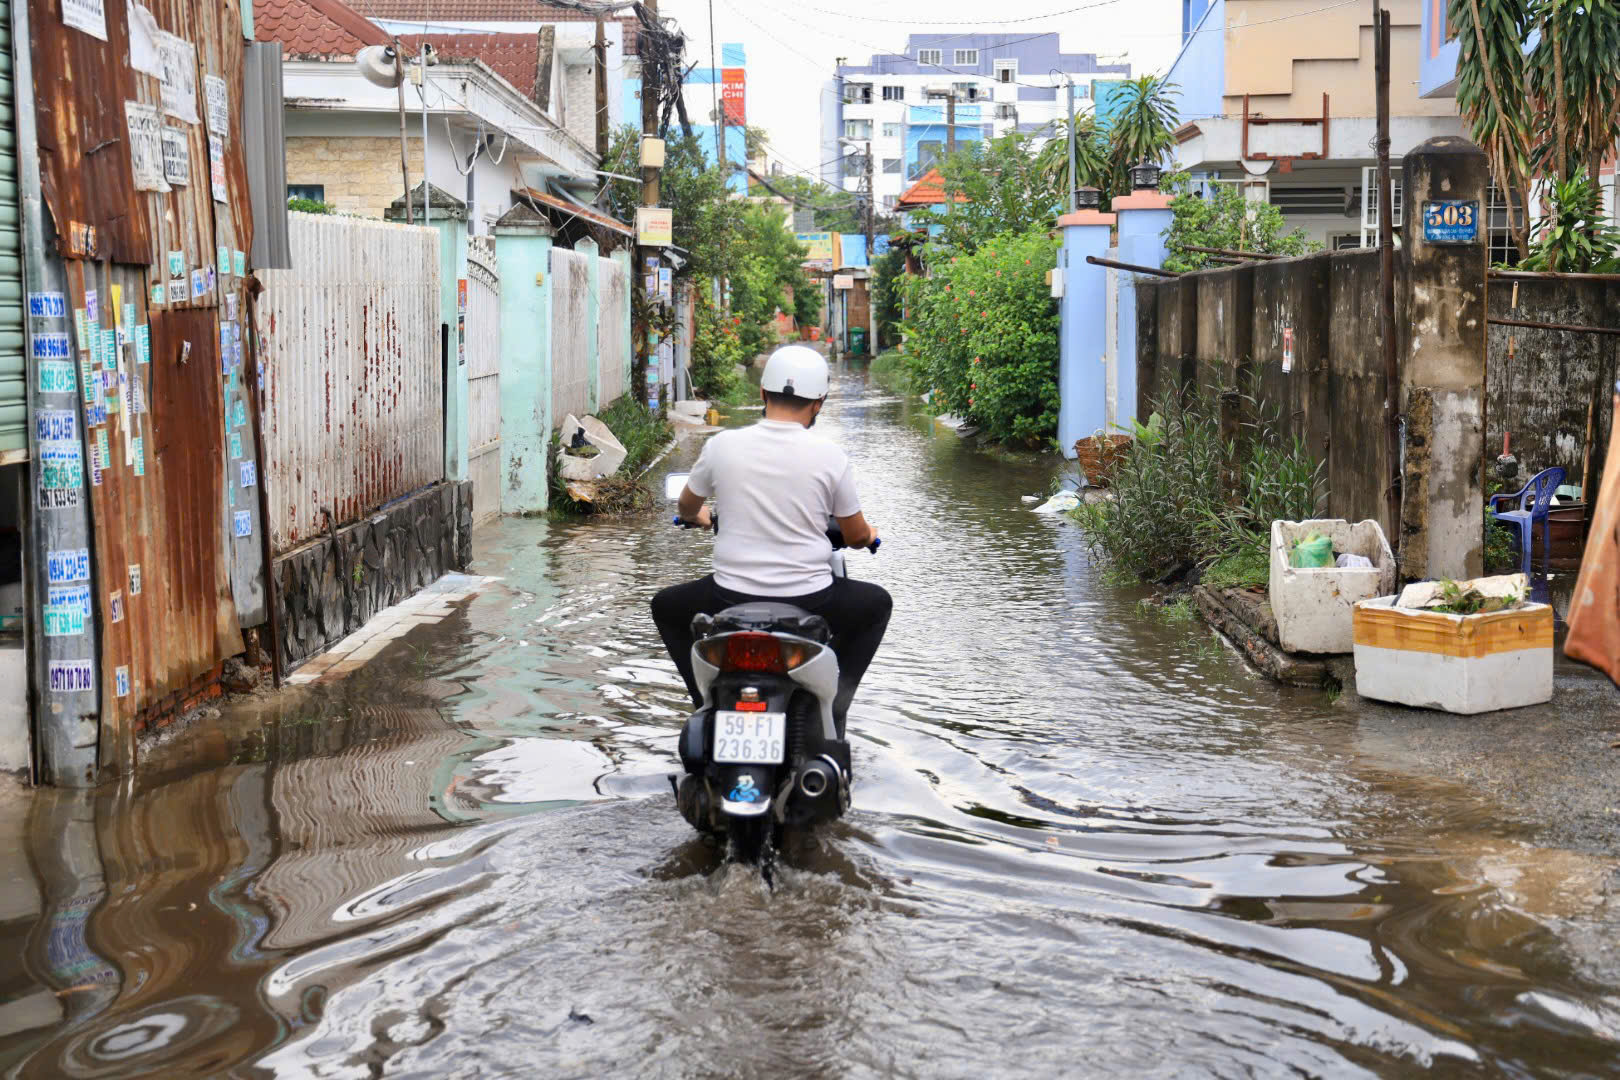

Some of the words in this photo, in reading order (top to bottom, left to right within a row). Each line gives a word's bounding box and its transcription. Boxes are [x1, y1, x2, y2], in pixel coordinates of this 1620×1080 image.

[1428, 205, 1473, 226] 503
[65, 558, 77, 580] 224
[78, 556, 88, 578] 557
[51, 667, 65, 690] 0971
[66, 668, 74, 689] 10
[75, 668, 82, 689] 70
[83, 667, 91, 688] 80
[725, 715, 773, 737] 59-F1
[718, 738, 780, 760] 236.36
